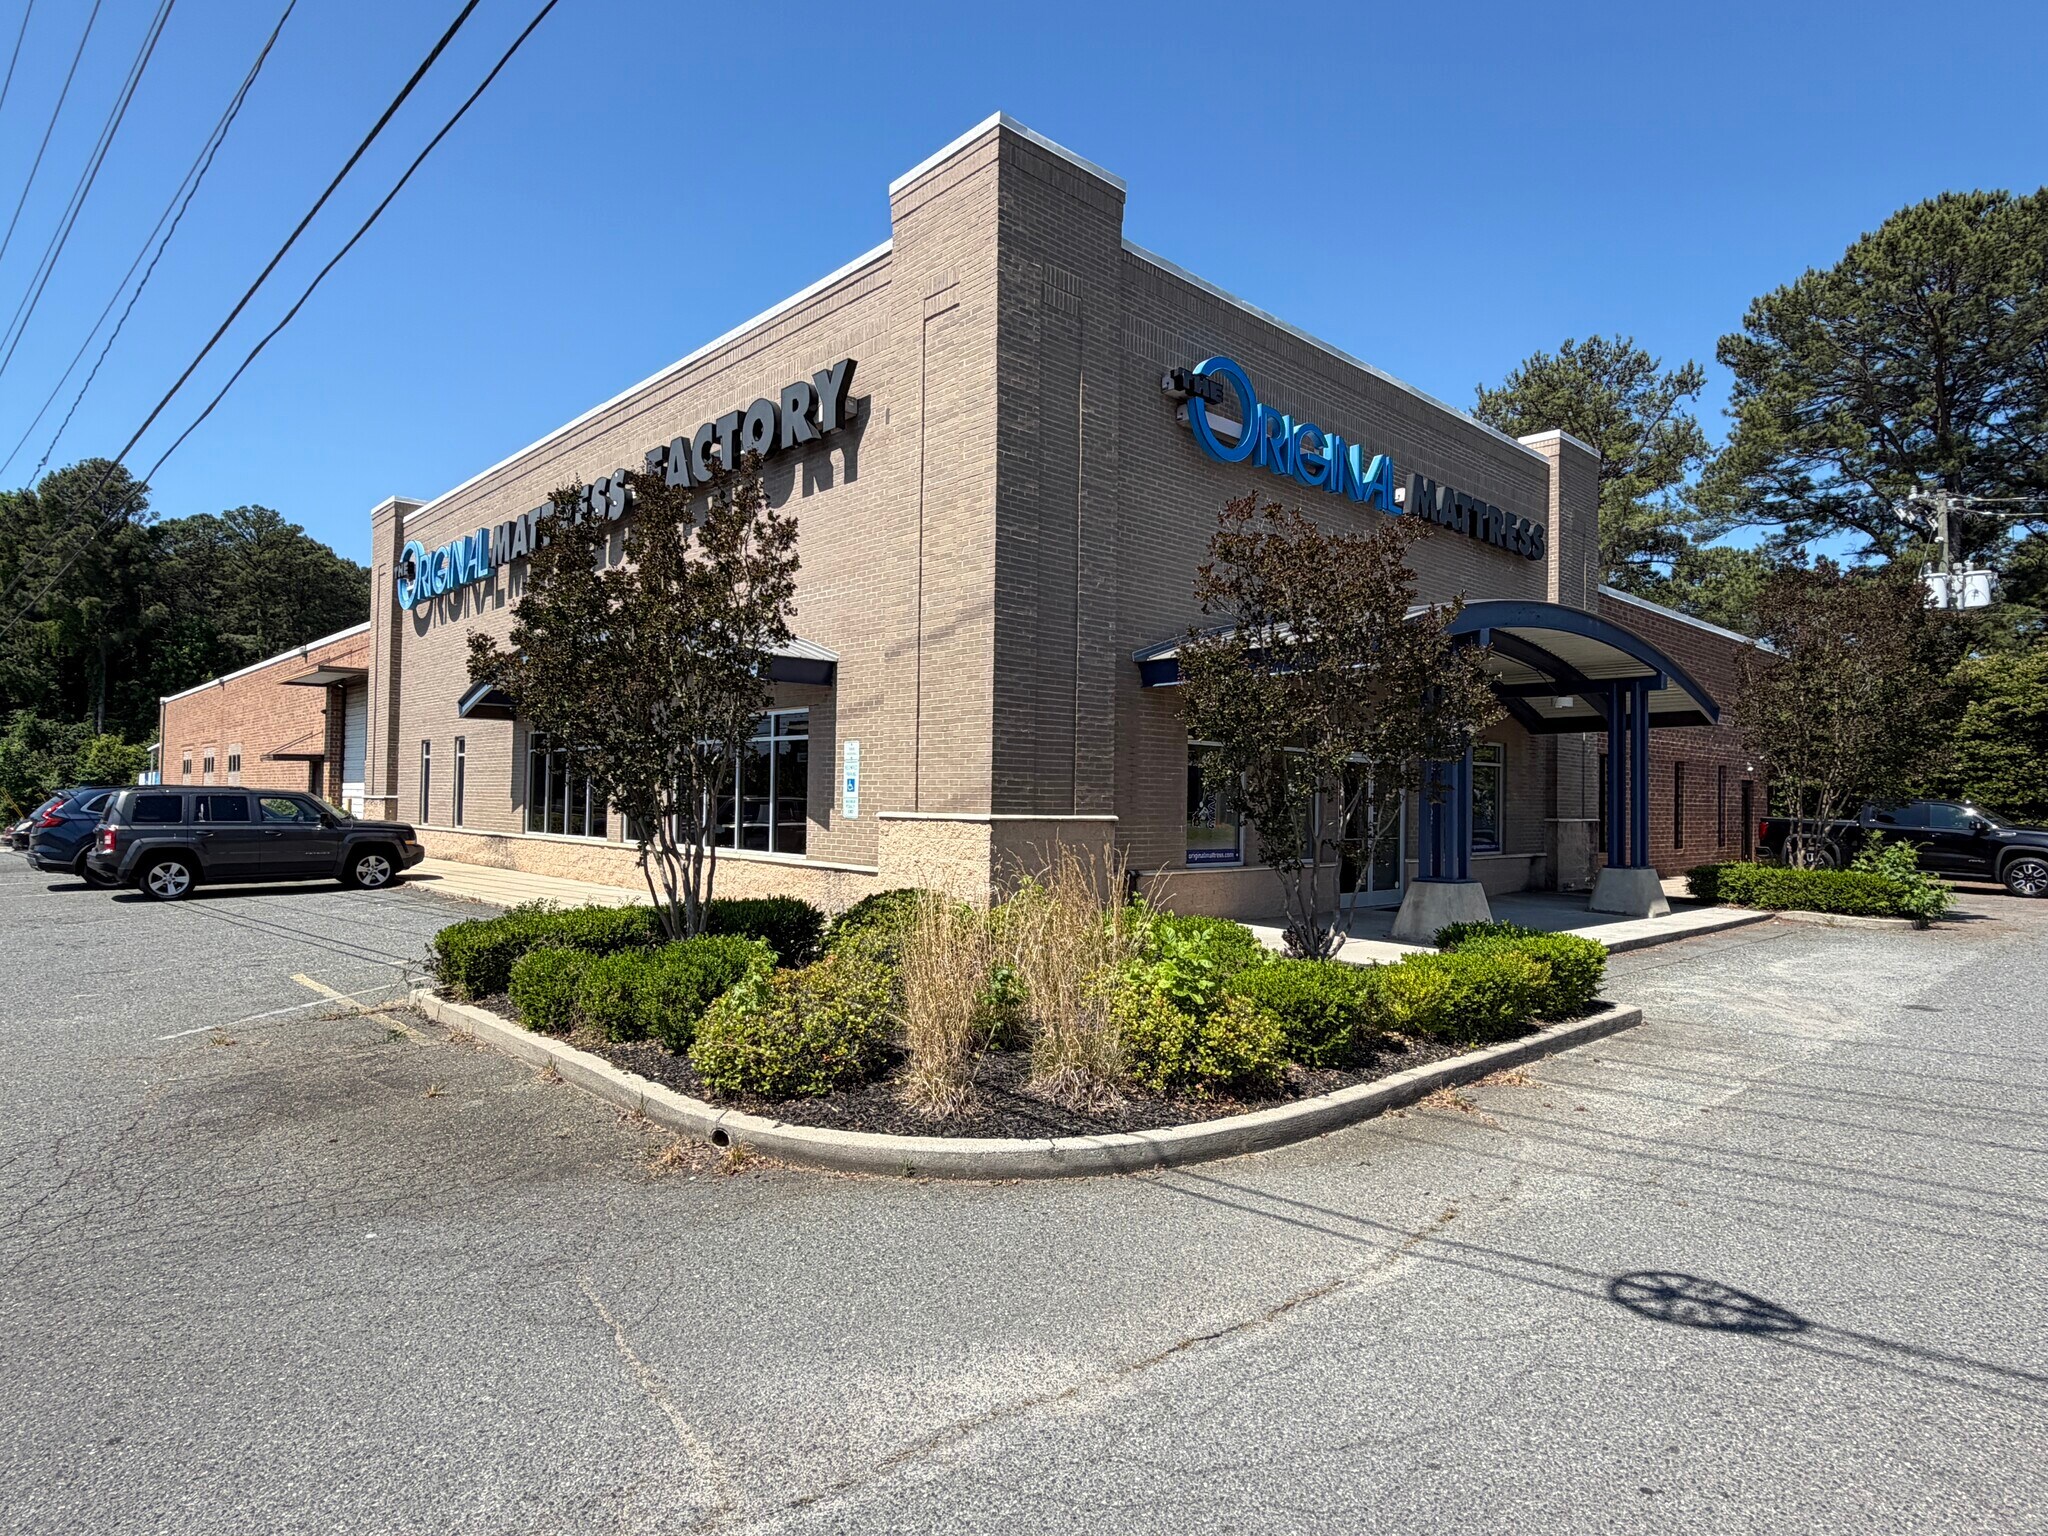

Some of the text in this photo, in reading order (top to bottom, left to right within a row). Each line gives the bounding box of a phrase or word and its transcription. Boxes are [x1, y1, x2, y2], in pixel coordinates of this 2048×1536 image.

[1170, 366, 1224, 406] THE
[397, 527, 491, 611] ORIGINAL
[645, 358, 858, 488] FACTORY
[1187, 355, 1545, 561] ORIGINAL MATTRESS
[394, 561, 416, 580] THE
